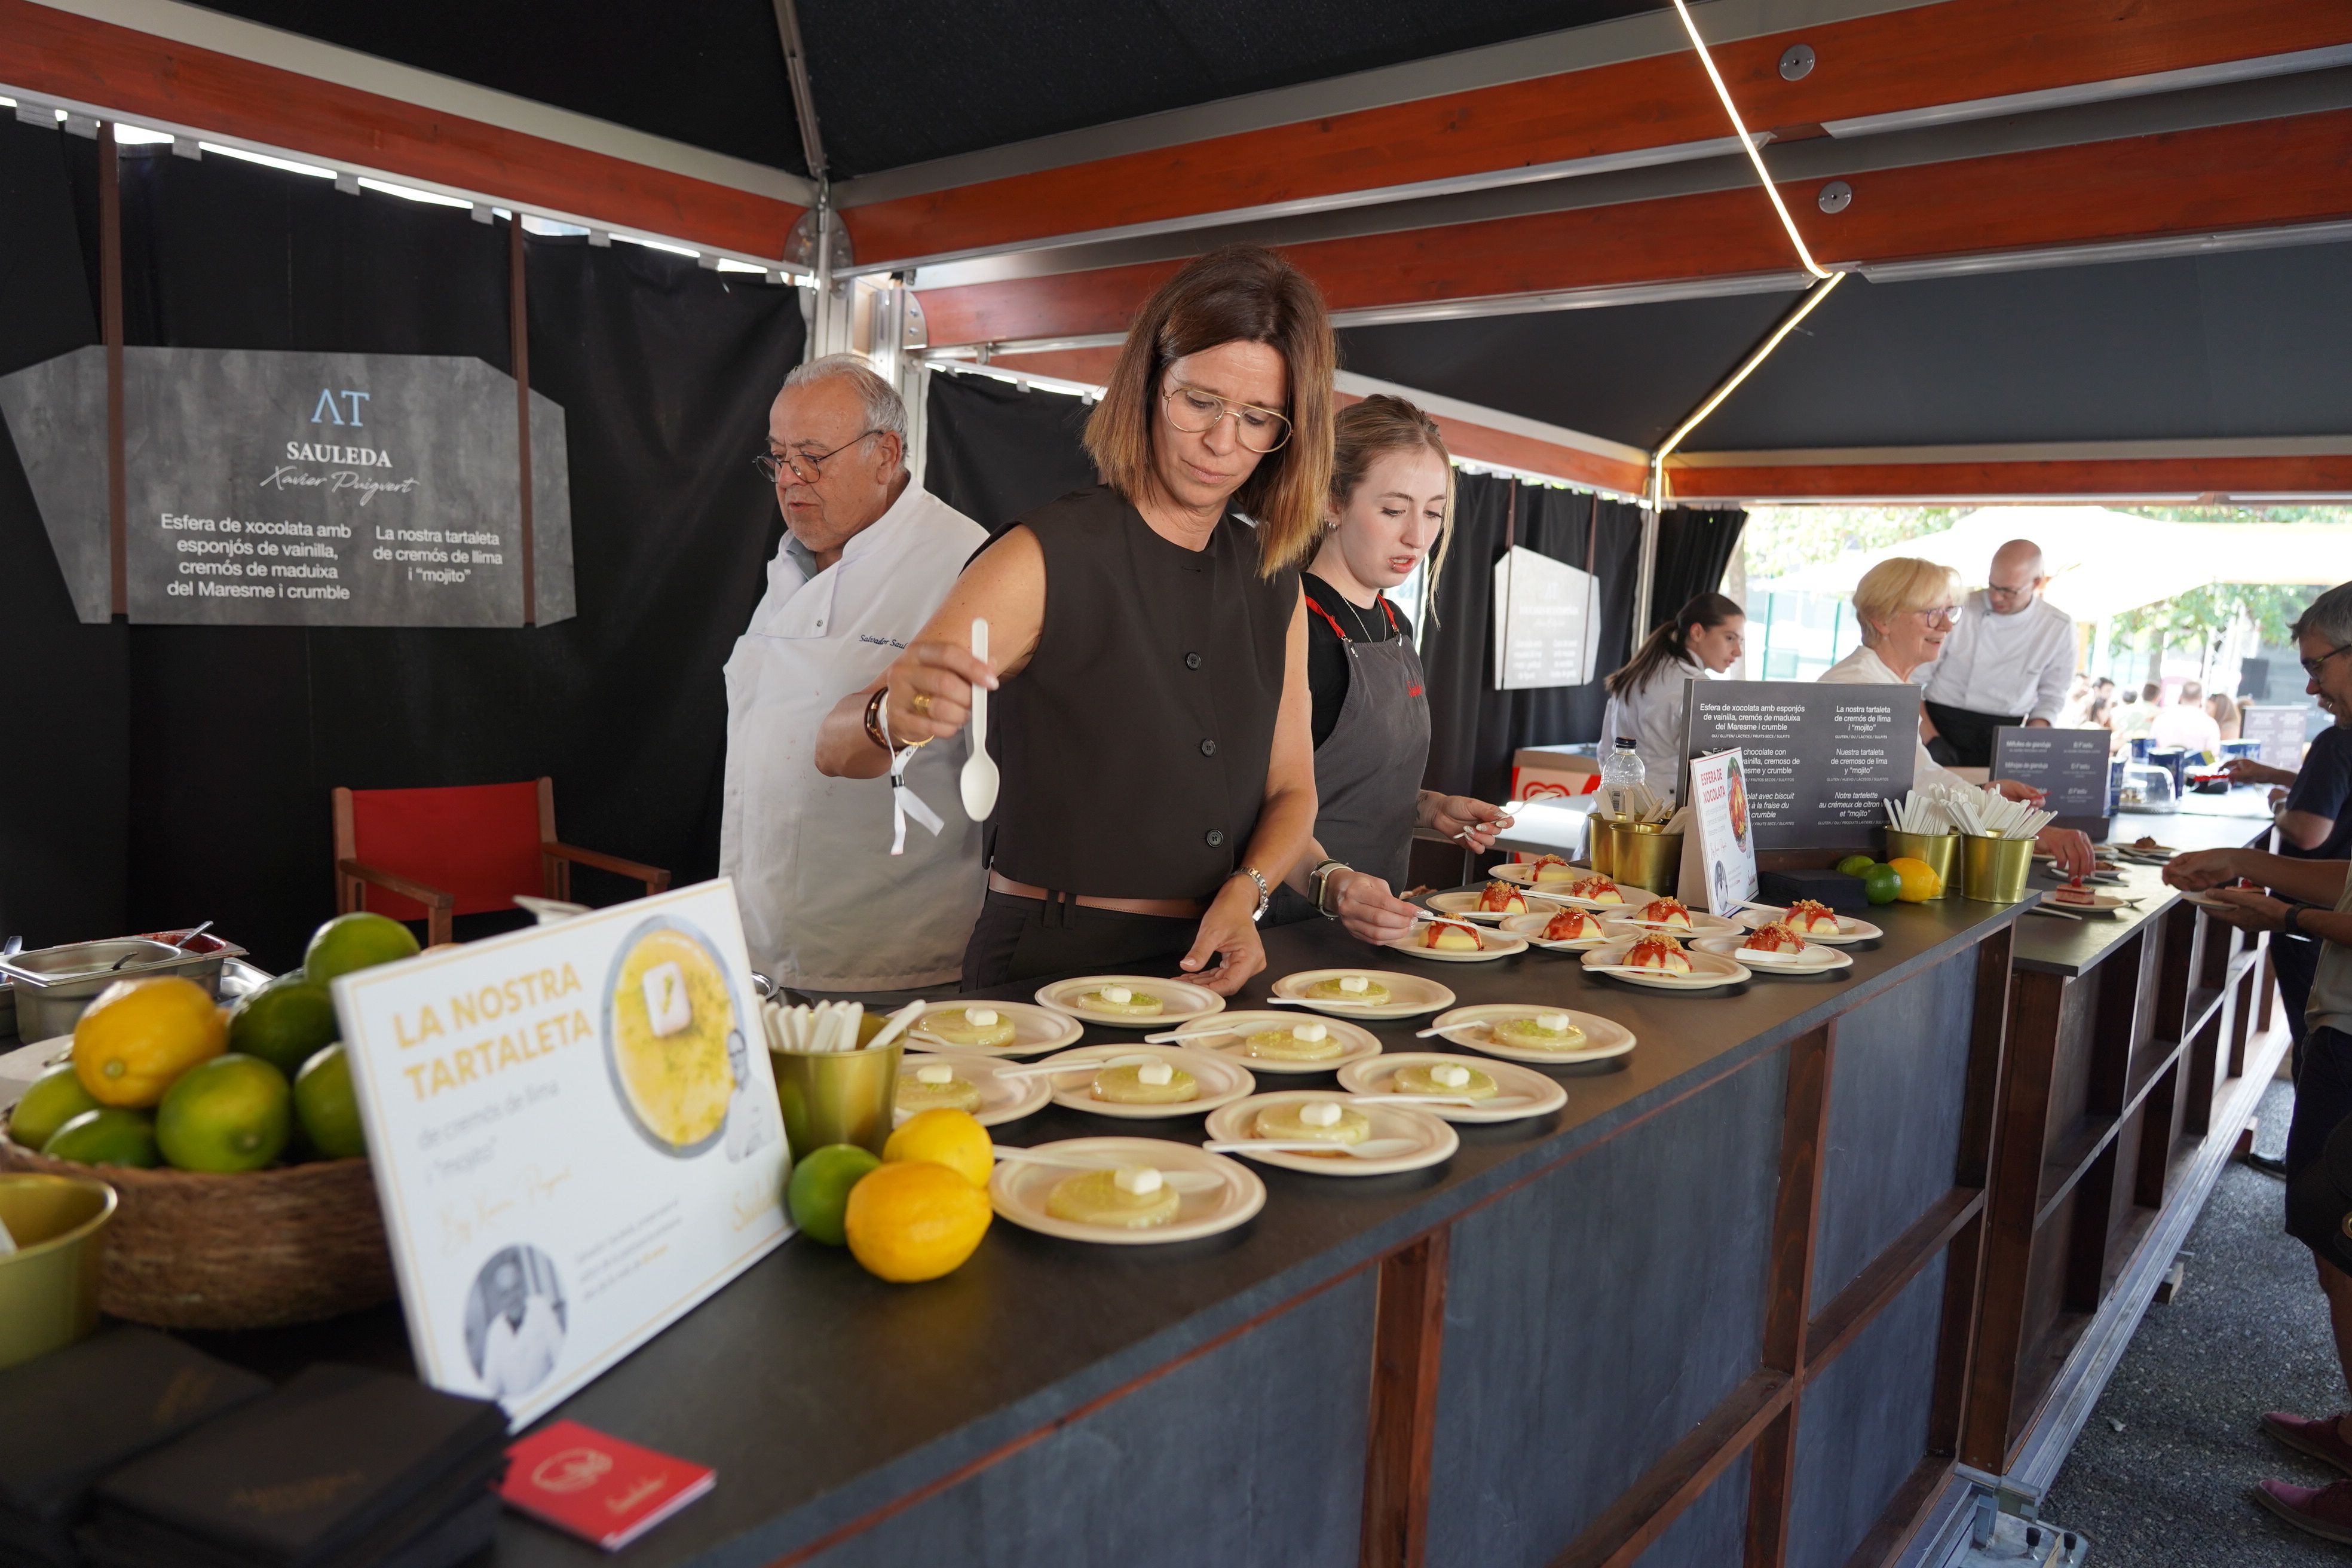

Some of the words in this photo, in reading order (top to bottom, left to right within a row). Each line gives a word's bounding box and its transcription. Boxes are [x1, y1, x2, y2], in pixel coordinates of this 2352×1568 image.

[286, 441, 393, 468] SAULEDA
[260, 466, 327, 491] Xavier
[331, 471, 421, 507] Puigvert
[161, 513, 216, 532] Esfera
[219, 517, 241, 532] de
[245, 520, 314, 537] xocolata
[317, 523, 352, 538] amb
[376, 525, 394, 540] La
[397, 529, 443, 543] nostra
[445, 529, 500, 546] tartaleta
[177, 538, 254, 557] esponjós
[257, 540, 278, 556] de
[282, 543, 339, 561] vainilla,
[373, 546, 393, 561] de
[395, 547, 448, 563] cremós
[451, 549, 469, 563] de
[472, 550, 503, 565] llima
[179, 559, 243, 575] cremós
[246, 562, 268, 577] de
[271, 564, 339, 579] maduixa
[408, 567, 412, 581] i
[167, 581, 194, 596] del
[198, 581, 275, 597] Maresme
[279, 584, 283, 598] i
[287, 585, 350, 599] crumble
[859, 635, 889, 645] Salvador
[890, 639, 908, 650] Saul
[1714, 713, 1737, 722] vainilla,
[1777, 705, 1805, 713] esponjós
[1701, 770, 1717, 786] ESFERA
[1717, 768, 1722, 781] DE
[1703, 785, 1726, 804] XOCOLATA
[393, 1005, 445, 1051] LA
[450, 962, 583, 1031] NOSTRA
[403, 1009, 593, 1101] TARTALETA
